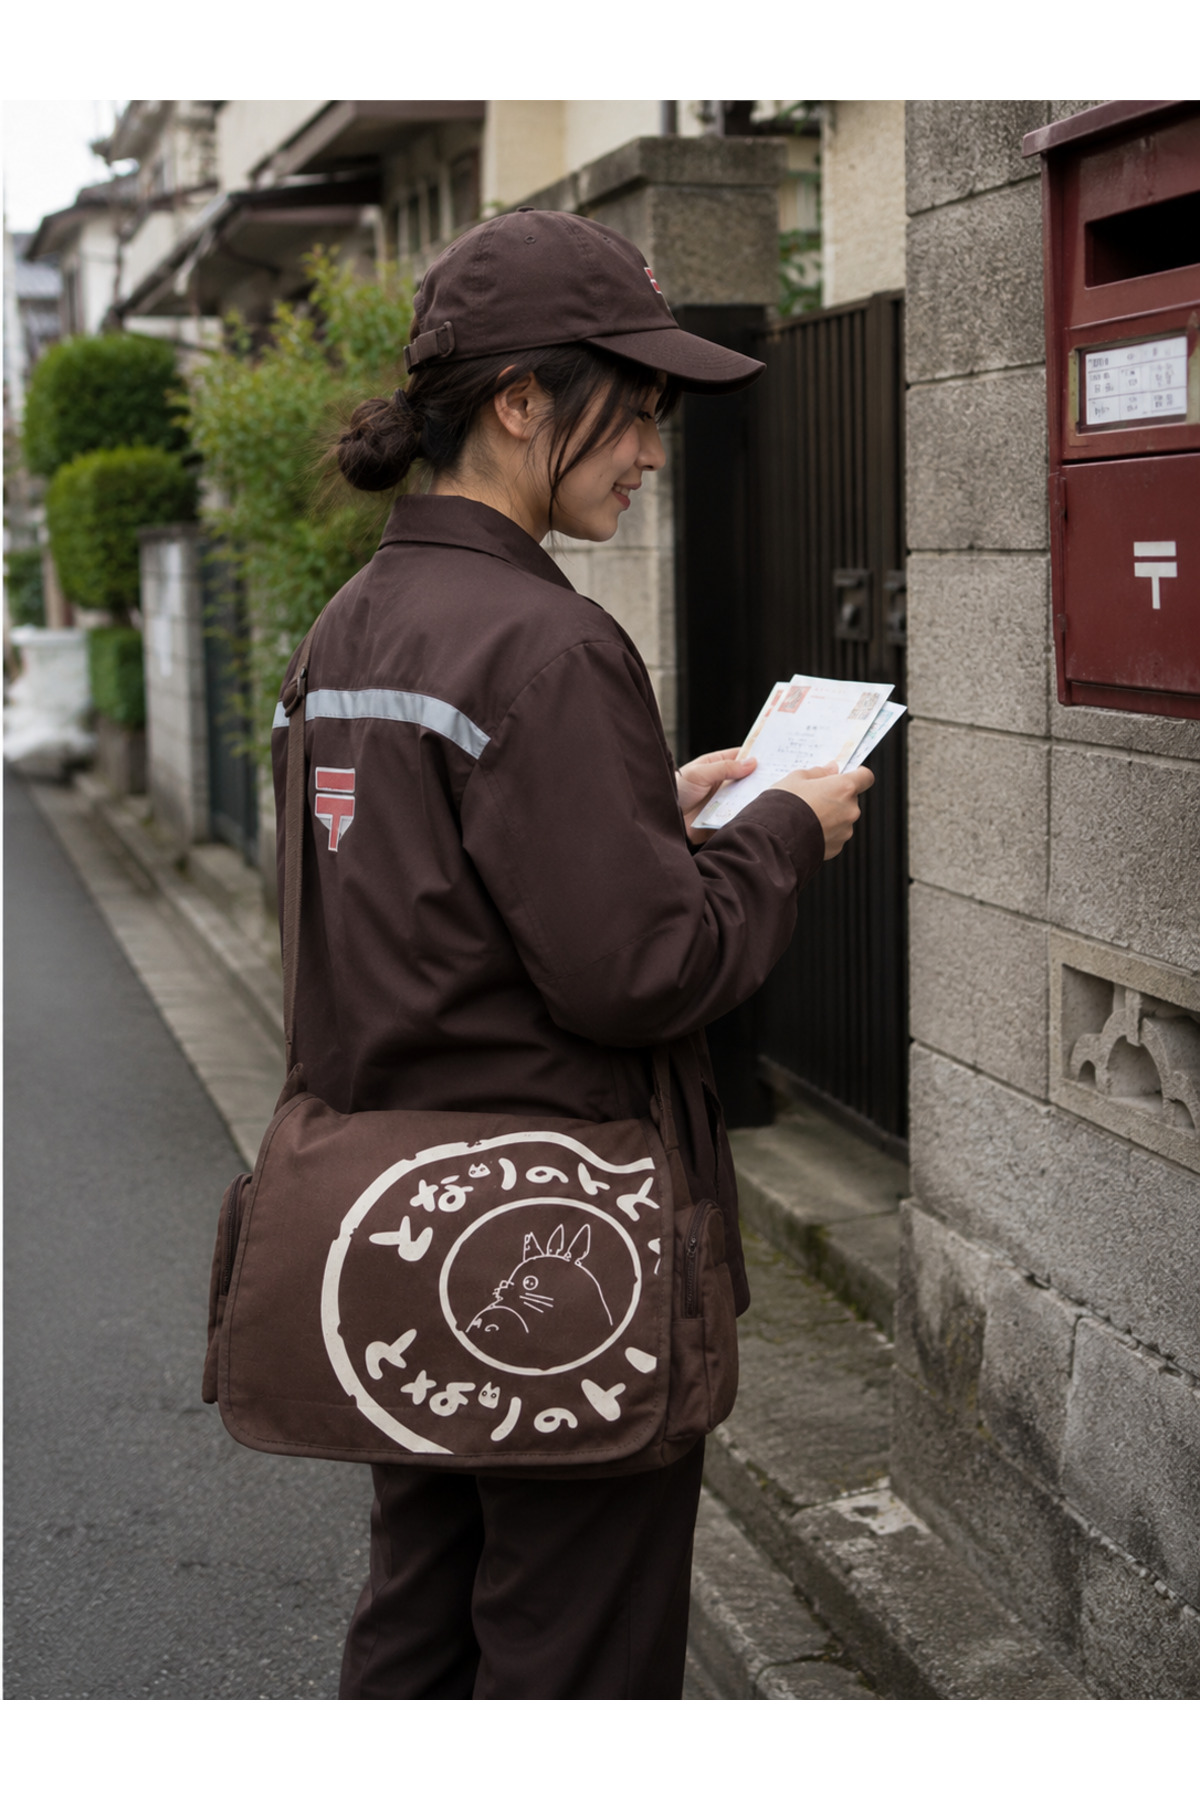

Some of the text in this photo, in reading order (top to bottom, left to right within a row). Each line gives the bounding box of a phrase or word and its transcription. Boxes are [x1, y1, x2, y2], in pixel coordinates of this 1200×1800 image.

[368, 1157, 661, 1275] となりのトト
